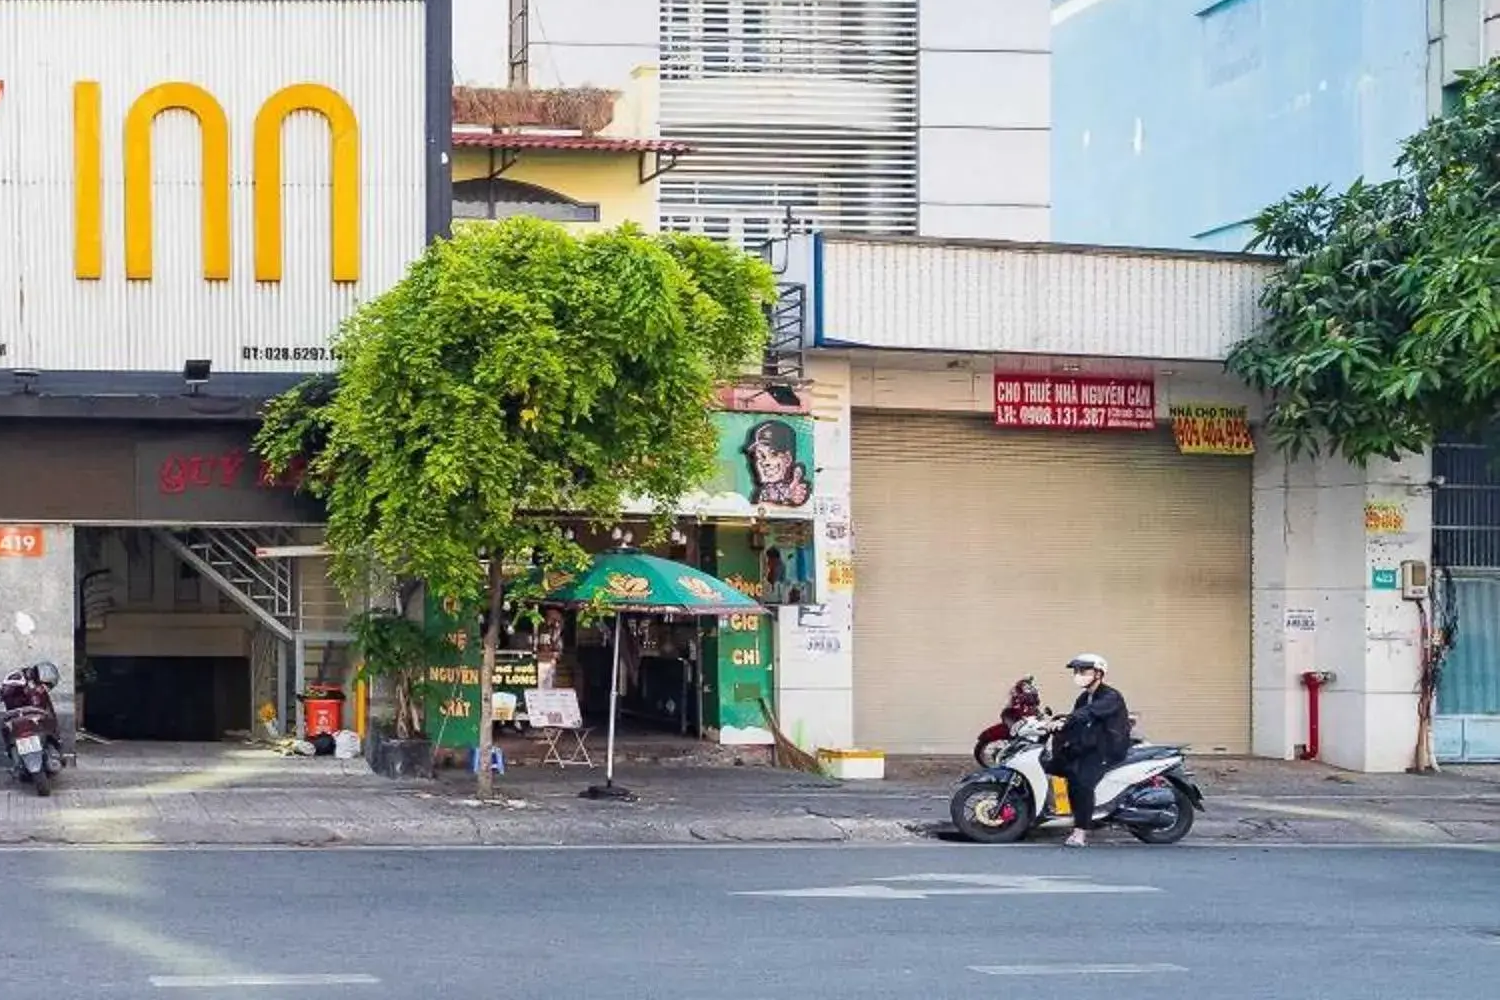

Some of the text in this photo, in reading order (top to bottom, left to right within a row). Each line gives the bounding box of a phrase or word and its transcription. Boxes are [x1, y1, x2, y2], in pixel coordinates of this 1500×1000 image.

[997, 381, 1021, 402] CHO
[1023, 378, 1052, 403] THUÊ
[1054, 380, 1077, 404] NHÀ
[996, 406, 1017, 425] LH:
[1195, 406, 1217, 418] CHO
[0, 535, 36, 552] 419
[429, 664, 479, 685] NGUYÊN
